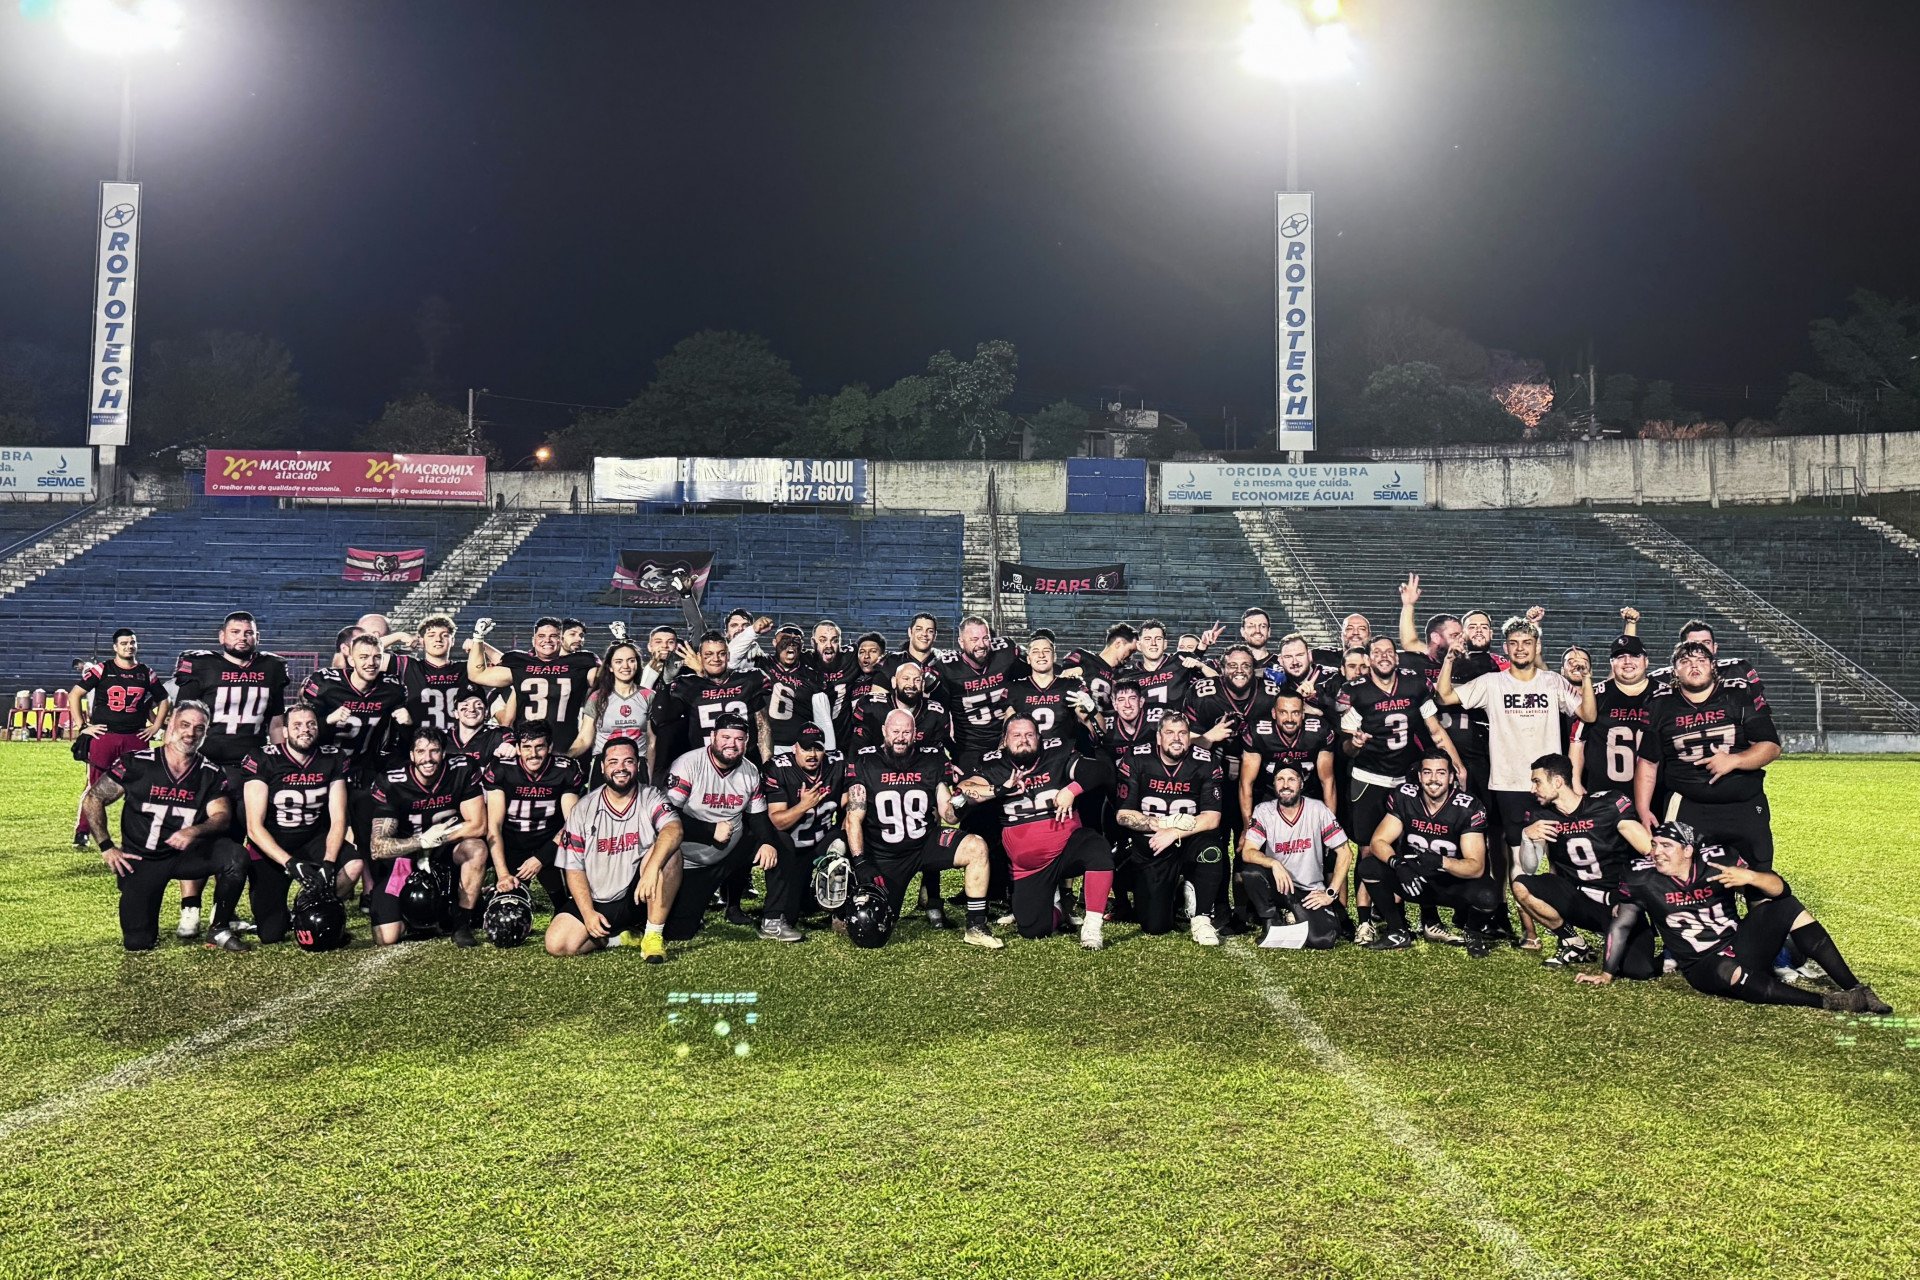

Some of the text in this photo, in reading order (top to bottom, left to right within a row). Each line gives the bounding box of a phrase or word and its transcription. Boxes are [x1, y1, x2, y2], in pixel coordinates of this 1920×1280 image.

[98, 231, 130, 409] ROTOTECH
[1285, 241, 1308, 415] ROTOTECH
[259, 459, 333, 472] MACROMIX
[402, 463, 475, 476] MACROMIX
[812, 460, 854, 484] AQUI
[1217, 466, 1369, 478] TORCIDA QUE VIBRA
[0, 476, 17, 487] A!
[37, 476, 86, 487] SEMAE
[274, 471, 318, 481] atacado
[417, 475, 461, 484] atacado
[1233, 477, 1241, 487] é
[1243, 479, 1250, 487] a
[1252, 479, 1292, 487] mesma
[1295, 479, 1317, 489] que
[267, 485, 300, 493] qualidade
[1167, 490, 1213, 501] SEMAE
[1231, 488, 1354, 501] ECONOMIZE ÁGUA!
[1373, 490, 1418, 501] SEMAE
[1035, 577, 1091, 593] BEARS
[221, 671, 265, 681] BEARS
[526, 664, 569, 673] BEARS
[963, 672, 1004, 690] BEARS
[1138, 671, 1174, 686] BEARS
[106, 685, 145, 713] 87
[520, 677, 572, 722] 31
[702, 686, 742, 698] BEARS
[1024, 694, 1060, 704] BEARS
[768, 682, 795, 720] 6
[1375, 698, 1411, 710] BEARS
[1504, 693, 1549, 708] BEARS
[213, 687, 270, 734] 44
[1675, 709, 1725, 727] BEARS
[1384, 713, 1408, 750] 3
[1671, 724, 1736, 763] 57
[1606, 726, 1645, 782] 6
[282, 772, 324, 783] BEARS
[881, 773, 922, 783] BEARS
[1149, 778, 1191, 792] BEARS
[150, 785, 195, 800] BEARS
[515, 786, 553, 795] BEARS
[273, 786, 328, 828] 85
[412, 794, 452, 809] BEARS
[702, 793, 744, 806] BEARS
[507, 799, 556, 832] 47
[875, 789, 929, 844] 98
[141, 802, 198, 850] 77
[1412, 819, 1448, 833] BEARS
[1555, 819, 1594, 833] BEARS
[1275, 838, 1312, 854] BEARS
[1566, 837, 1603, 881] 9
[1664, 887, 1713, 904] BEARS
[1665, 902, 1739, 953] 24
